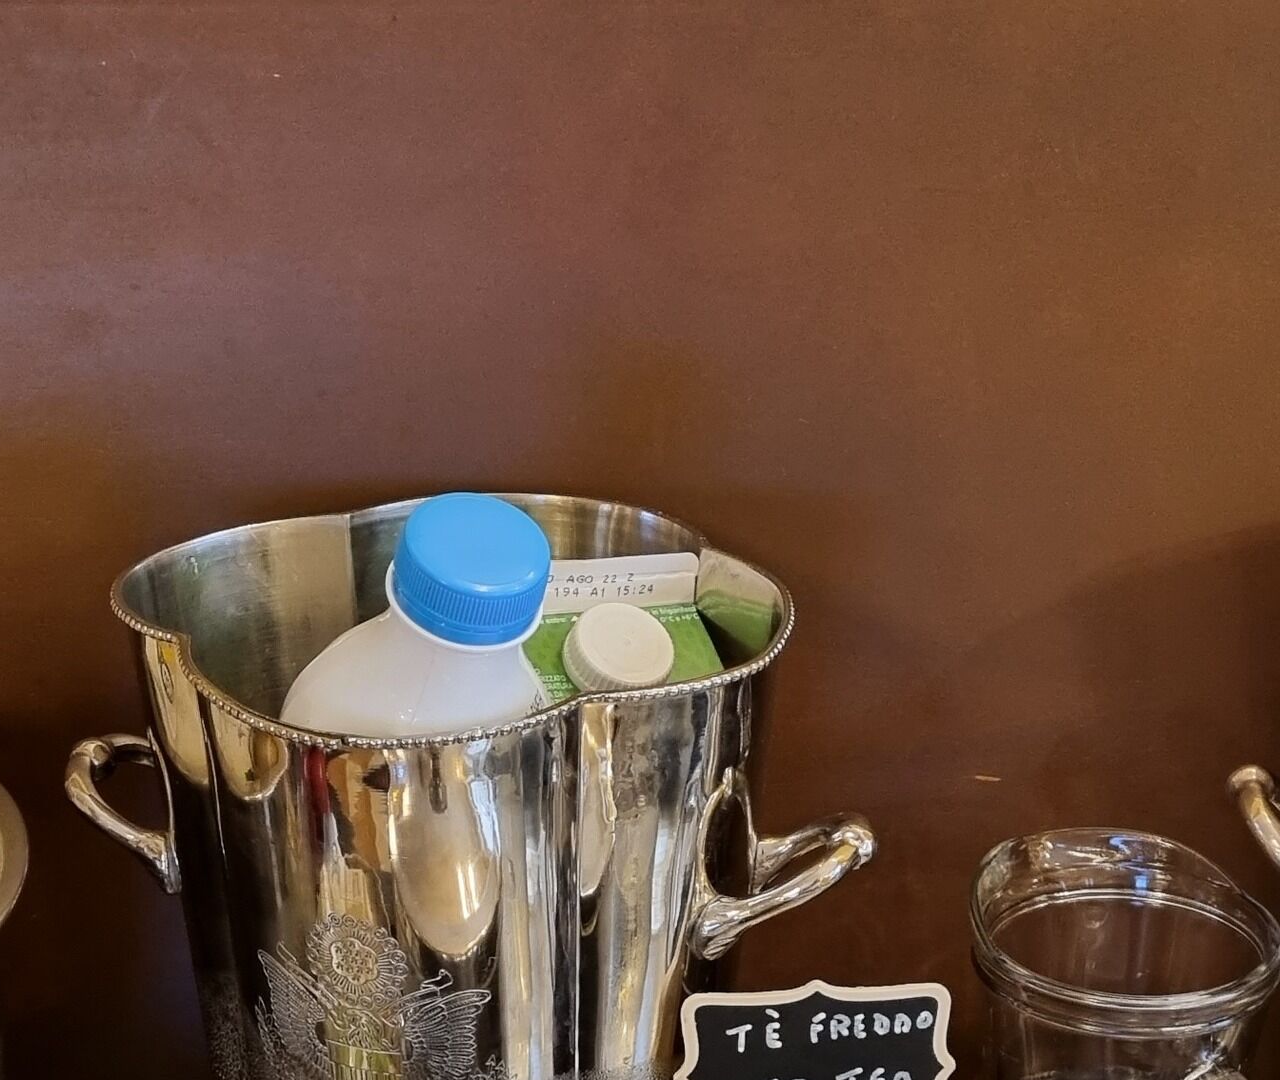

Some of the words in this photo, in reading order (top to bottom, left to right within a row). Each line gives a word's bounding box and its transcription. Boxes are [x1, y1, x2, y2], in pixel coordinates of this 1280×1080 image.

[566, 575, 594, 584] AGO
[603, 574, 617, 583] 22
[554, 586, 579, 598] 194
[616, 584, 654, 597] 15:24
[809, 1010, 934, 1044] FREDDO
